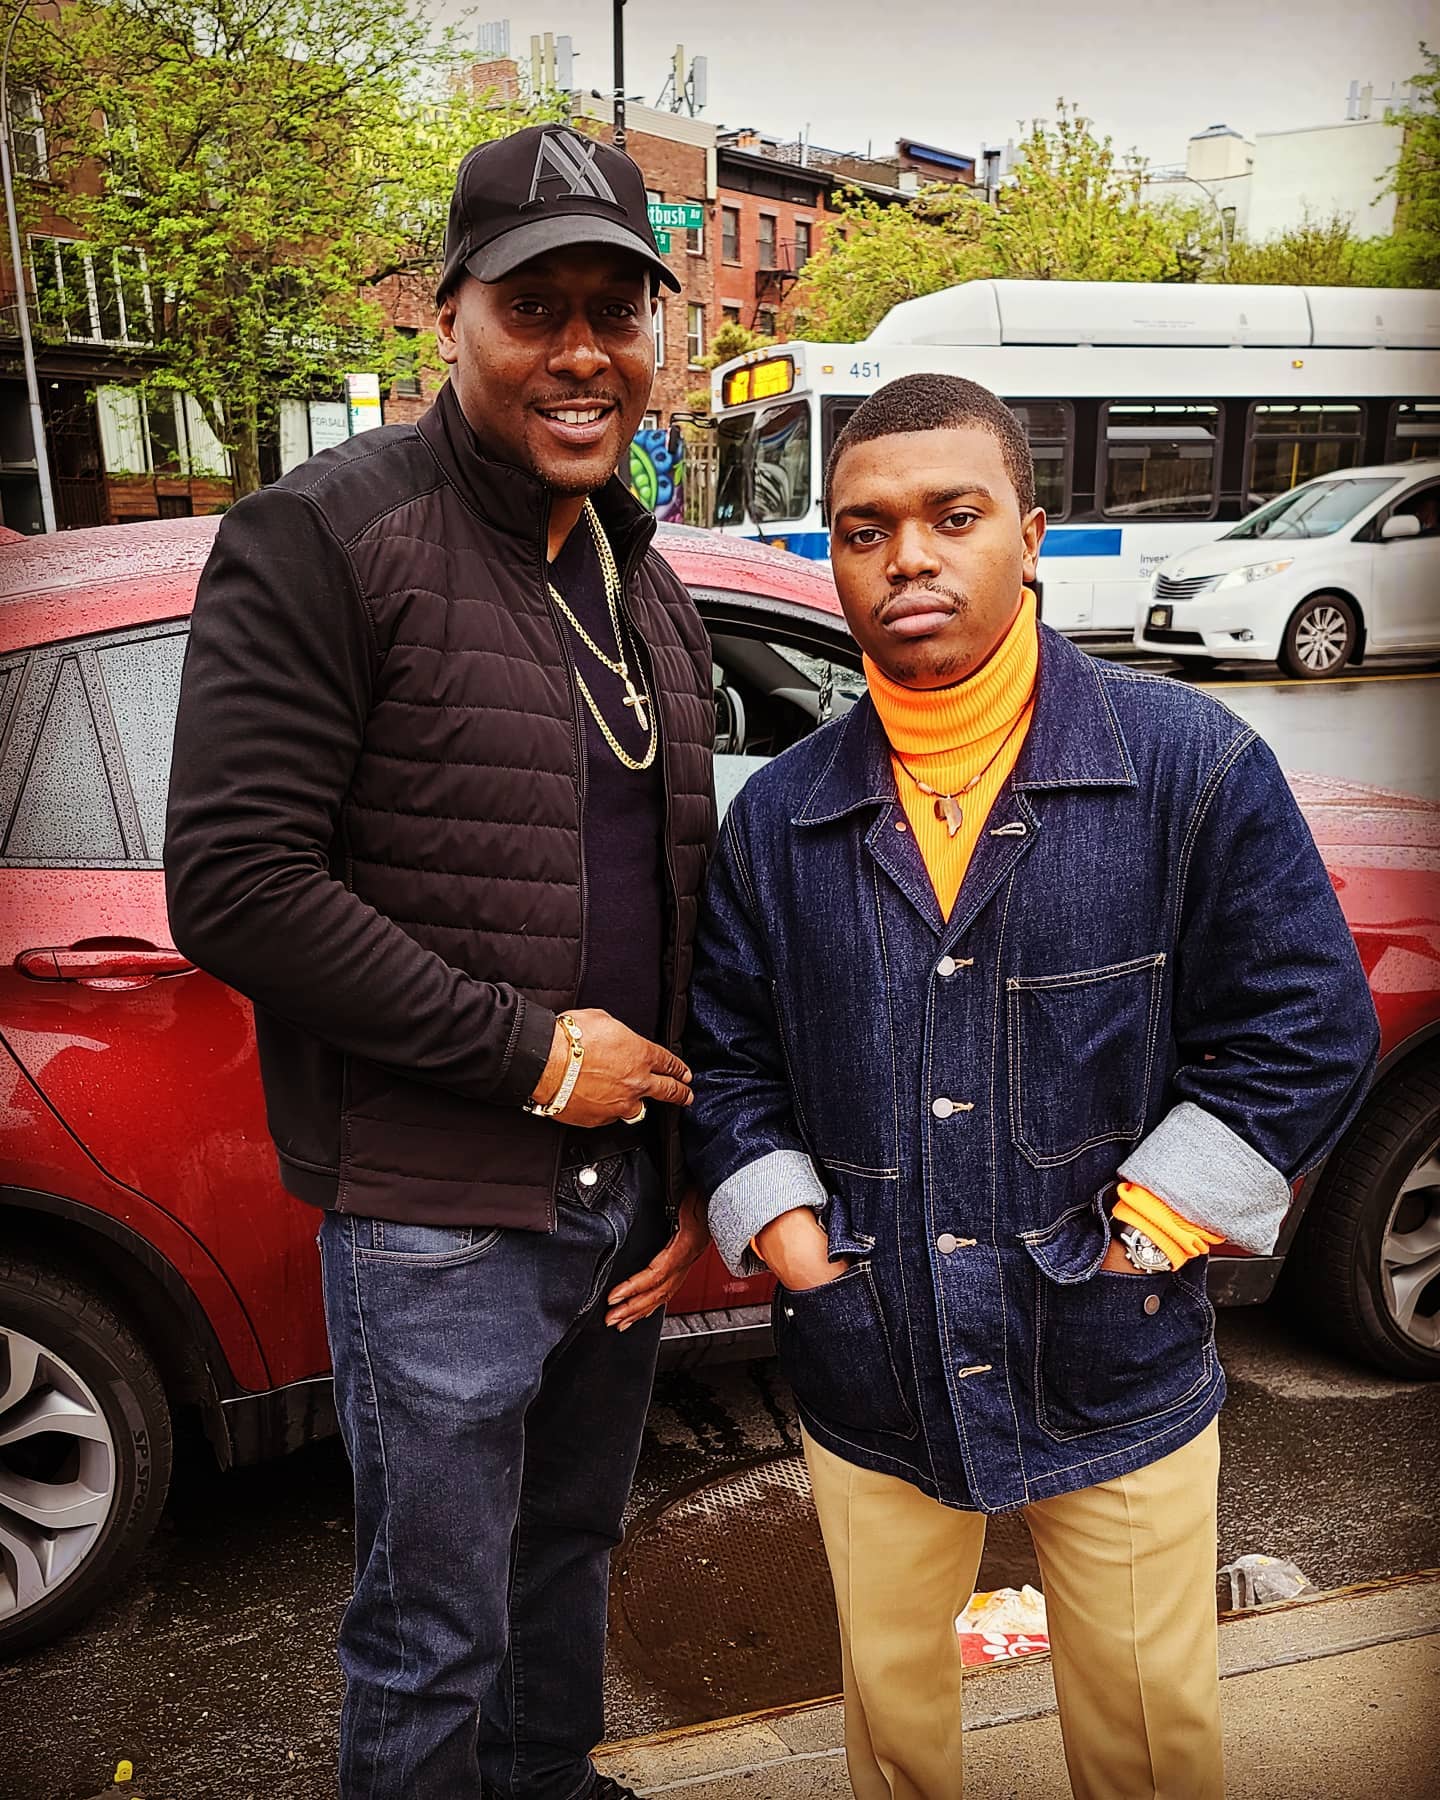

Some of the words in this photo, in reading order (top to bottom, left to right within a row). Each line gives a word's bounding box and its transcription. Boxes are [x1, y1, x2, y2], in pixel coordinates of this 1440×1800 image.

[648, 206, 686, 225] tbush
[849, 362, 881, 378] 451
[132, 1430, 149, 1459] SP
